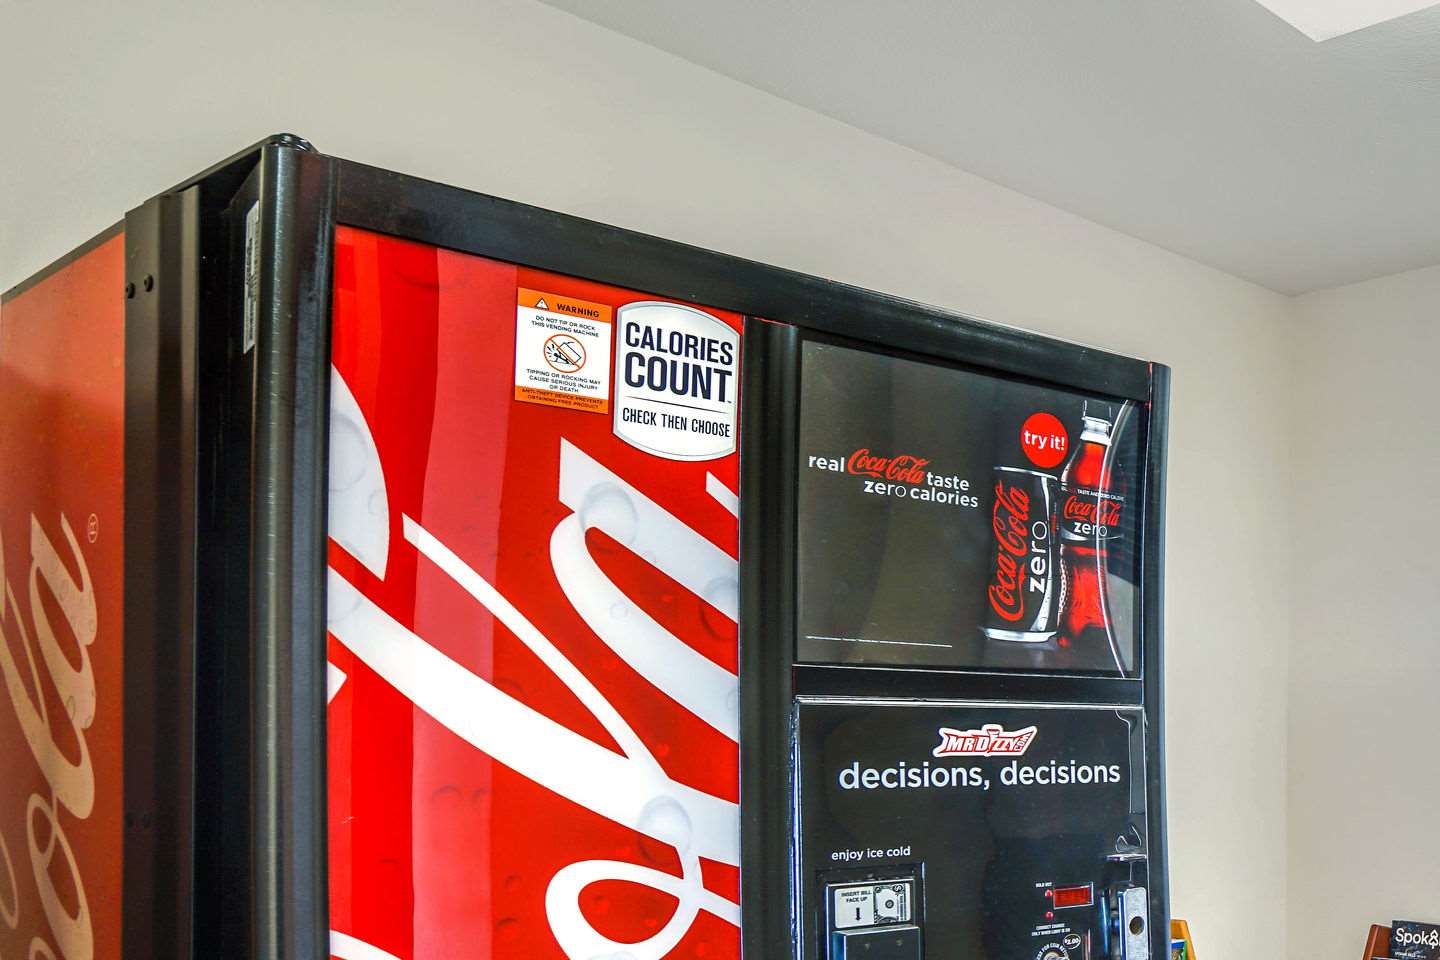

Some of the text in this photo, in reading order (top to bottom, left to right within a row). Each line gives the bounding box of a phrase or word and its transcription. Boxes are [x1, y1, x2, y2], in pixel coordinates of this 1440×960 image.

[557, 303, 599, 318] WARNING
[546, 322, 572, 333] VENDING
[573, 328, 600, 338] MACHINE
[625, 321, 734, 366] CALORIES
[526, 368, 550, 377] TIPPING
[561, 374, 588, 383] ROCKING
[529, 375, 598, 391] CAUSE SERIOUS INJURY
[624, 352, 733, 403] COUNT
[622, 407, 731, 438] CHECK THEN CHOOSE
[1024, 430, 1065, 452] try it!
[808, 448, 970, 491] real Coca-Cola taste
[863, 479, 979, 508] zero calories
[1073, 521, 1107, 537] zero
[987, 480, 1031, 621] Coca-Cola
[1030, 521, 1047, 593] zero
[838, 760, 1121, 790] decisions, decisions
[831, 845, 911, 861] enjoy ice cold
